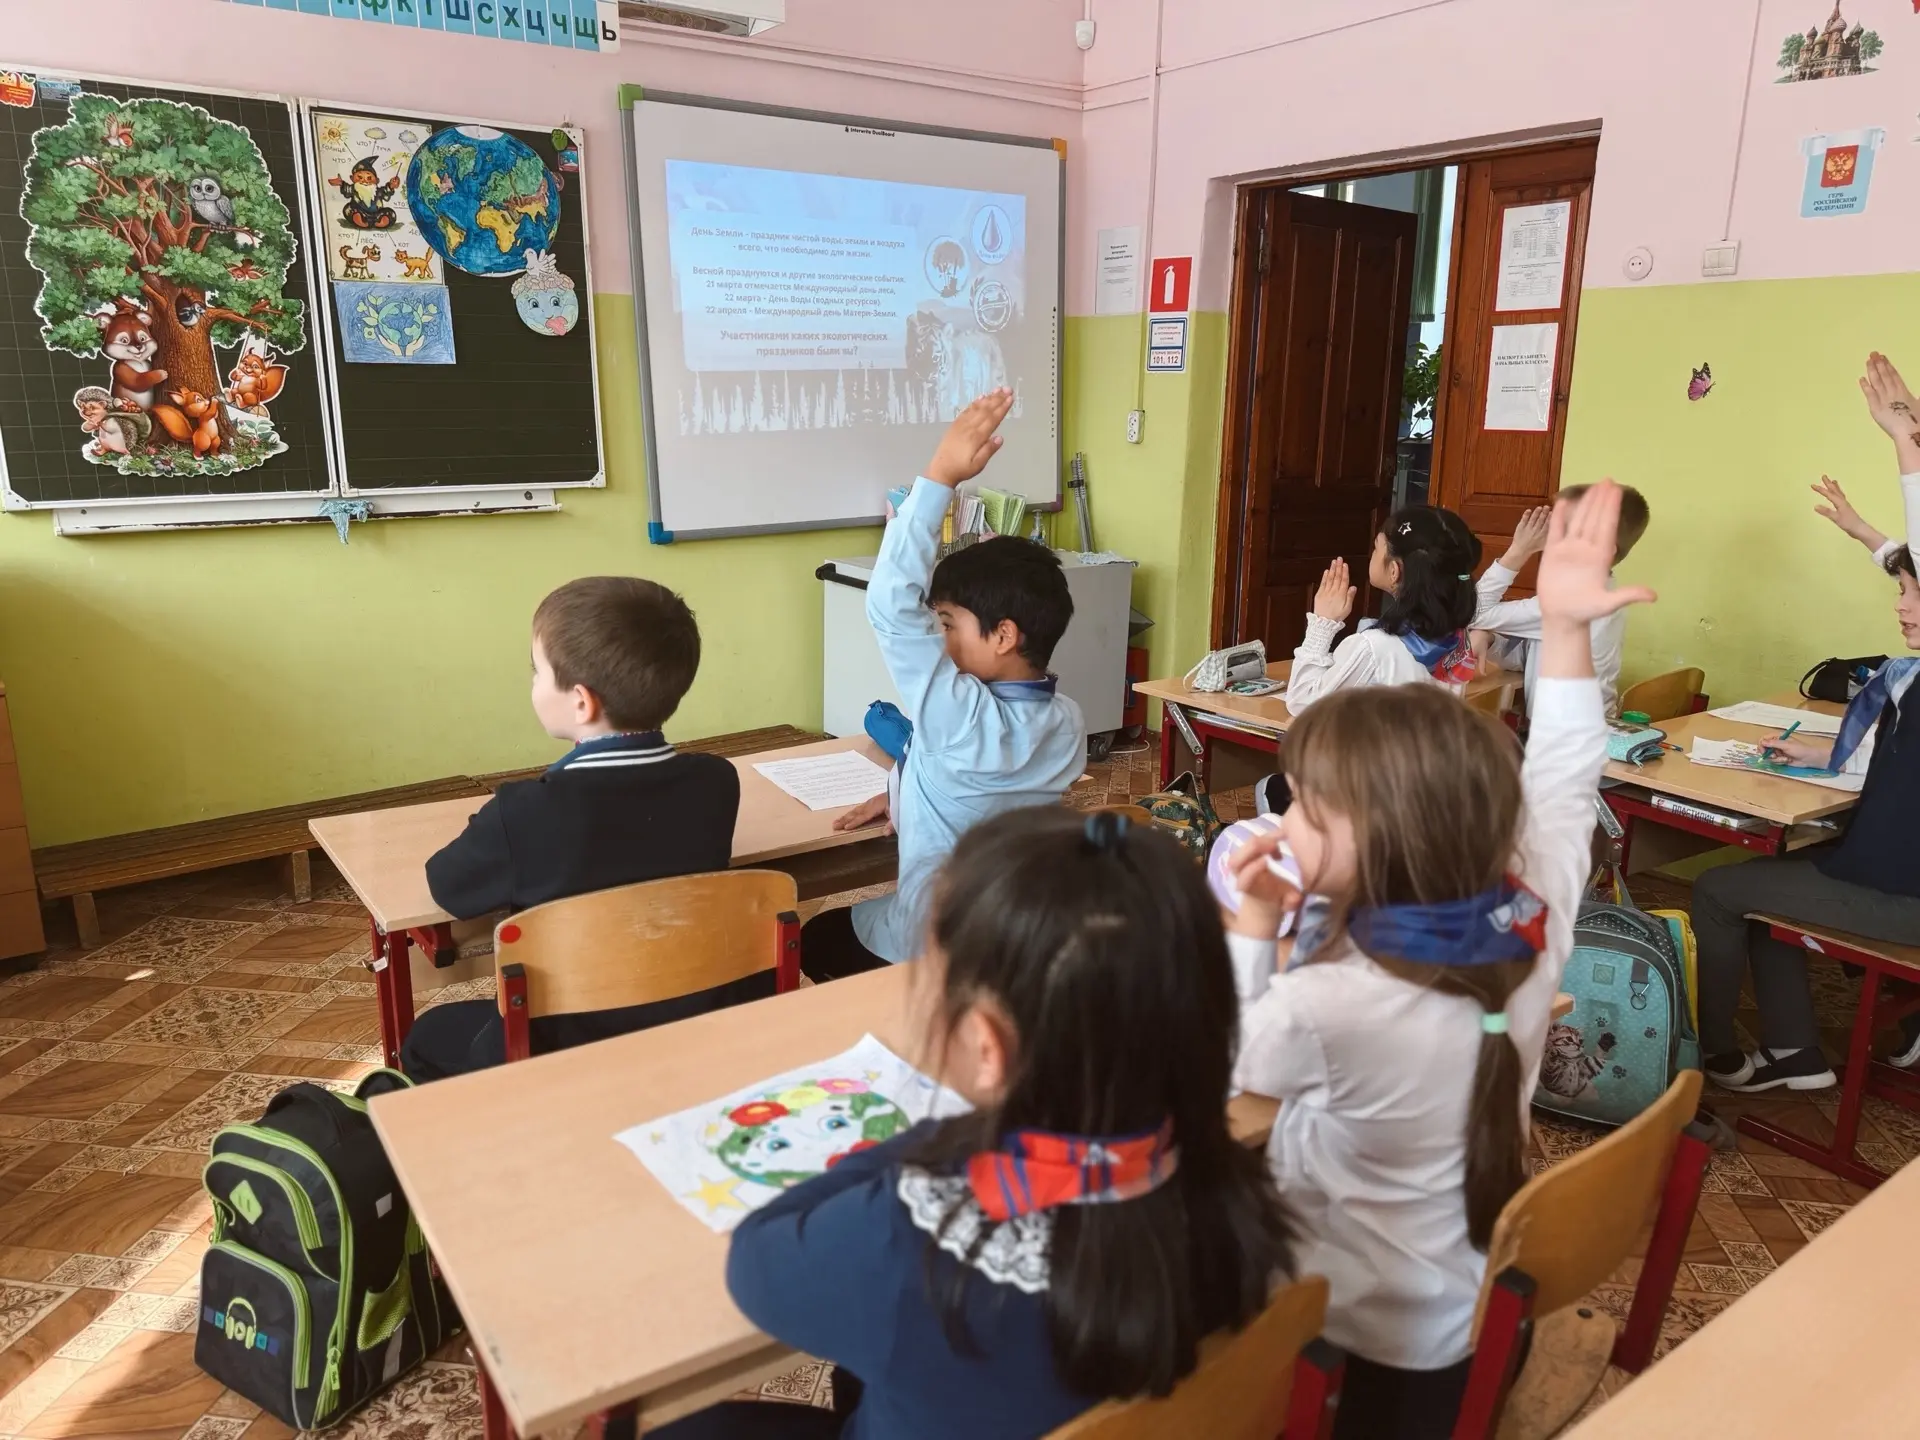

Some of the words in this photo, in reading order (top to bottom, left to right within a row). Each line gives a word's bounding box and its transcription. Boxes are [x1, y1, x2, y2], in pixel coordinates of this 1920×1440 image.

[477, 3, 494, 24] с
[526, 9, 545, 36] ц
[551, 13, 568, 35] ч
[575, 17, 598, 44] щ
[602, 20, 617, 42] ь
[850, 127, 871, 135] Interwrite
[872, 129, 895, 138] DualBoard
[691, 227, 713, 236] День
[715, 228, 743, 238] Земли
[750, 231, 789, 242] праздник
[791, 234, 820, 242] чистой
[821, 236, 844, 245] воды,
[876, 241, 905, 249] воздуха
[738, 244, 763, 252] всего,
[780, 246, 829, 256] необходимо
[830, 249, 845, 257] для
[692, 266, 724, 275] Весной
[726, 268, 780, 279] празднуются
[788, 271, 816, 281] другие
[817, 272, 873, 282] экологические
[706, 280, 715, 288] 21
[716, 282, 742, 290] марта
[744, 283, 792, 291] отмечается
[793, 283, 858, 294] Международный
[859, 287, 877, 295] день
[877, 287, 896, 295] леса,
[724, 293, 734, 301] 22
[736, 295, 762, 304] марта
[768, 294, 789, 304] День
[790, 295, 811, 305] Воды
[812, 296, 844, 305] (водных
[705, 306, 715, 314] 22
[717, 307, 747, 316] апреля
[754, 307, 822, 317] Международный
[823, 309, 841, 317] день
[720, 330, 790, 340] Участниками
[791, 333, 820, 341] каких
[822, 333, 888, 341] экологических
[756, 347, 815, 357] праздников
[816, 345, 840, 356] были
[842, 346, 858, 356] вы?
[1167, 355, 1179, 364] 112
[1672, 804, 1715, 821] ПЛАСТИЛИН
